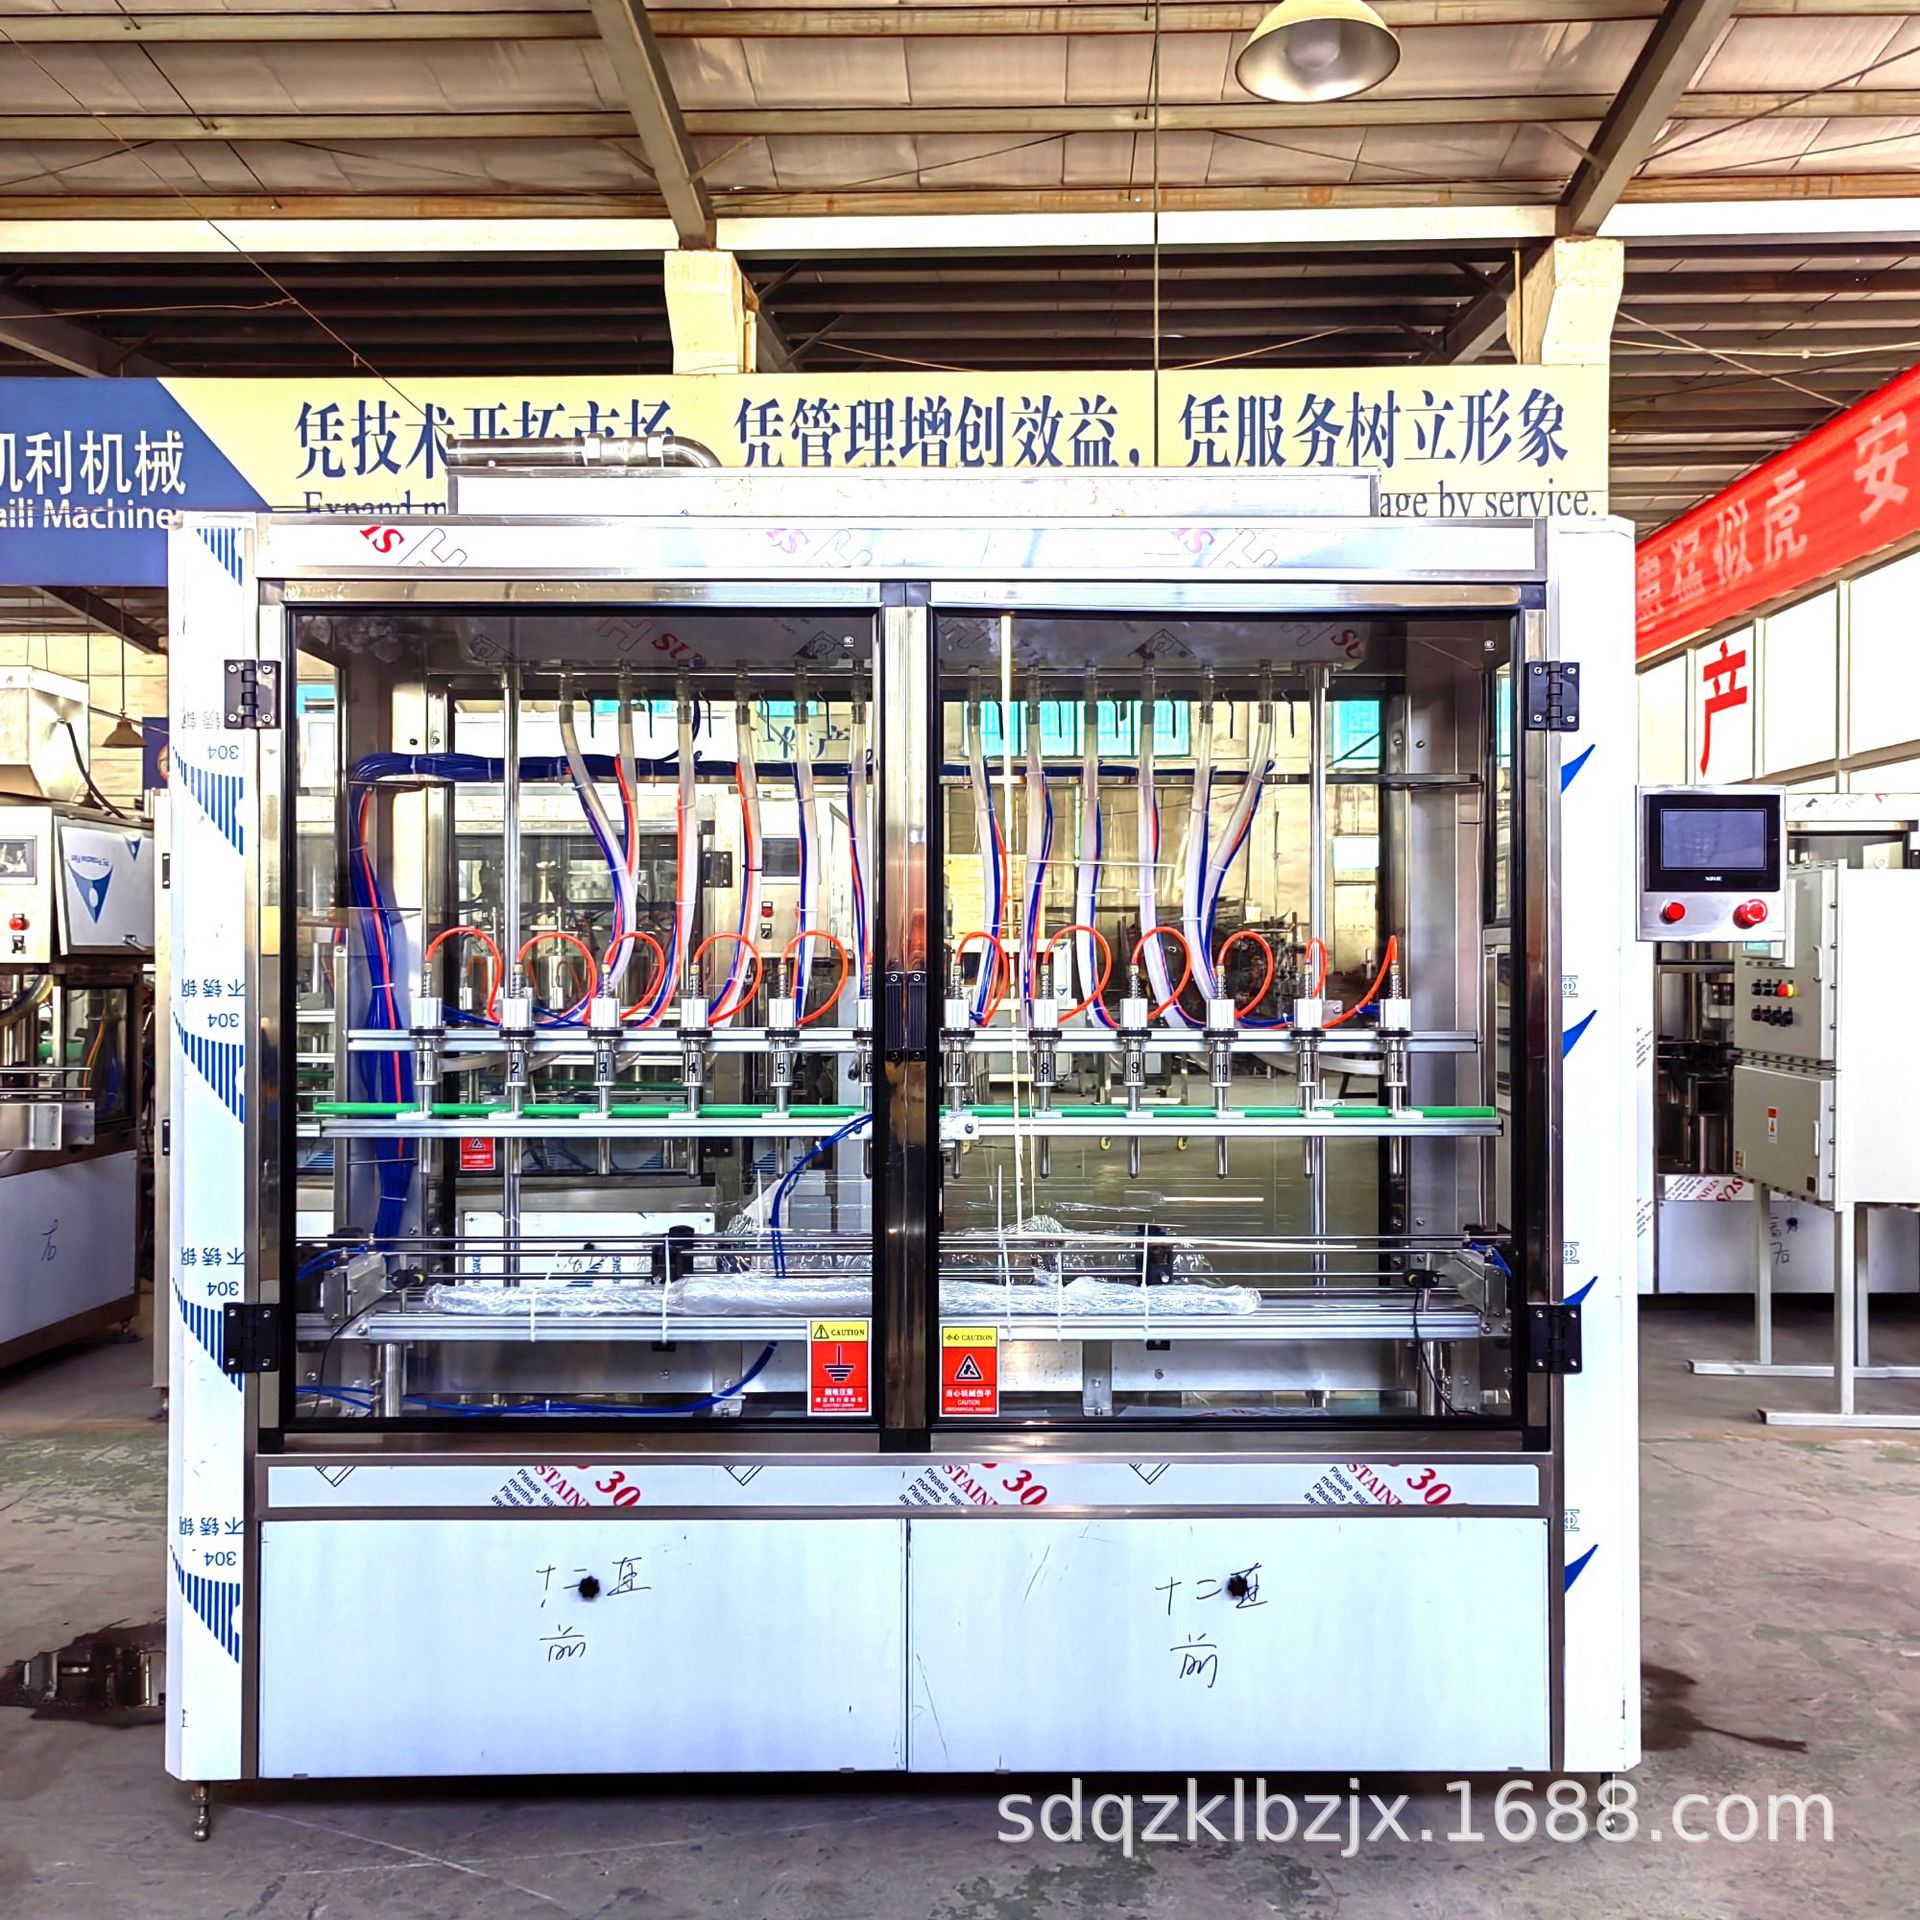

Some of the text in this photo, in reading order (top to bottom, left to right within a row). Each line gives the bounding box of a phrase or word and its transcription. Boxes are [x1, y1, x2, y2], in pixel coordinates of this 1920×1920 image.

[1178, 388, 1568, 468] 凭服务树立形象
[1854, 410, 1908, 524] 安
[1485, 478, 1597, 516] service.
[181, 711, 221, 730] 锈钢
[1703, 639, 1748, 778] 产
[207, 745, 239, 760] 304
[181, 979, 245, 998] 不锈钢
[207, 1013, 239, 1028] 304
[1216, 1063, 1228, 1075] 10
[181, 1246, 246, 1265] 不锈钢
[206, 1280, 240, 1296] 304
[508, 1477, 534, 1505] months
[517, 1468, 541, 1495] Please
[915, 1477, 942, 1504] months
[924, 1467, 949, 1493] Please
[1320, 1475, 1346, 1501] months
[1329, 1466, 1353, 1492] Please
[179, 1517, 244, 1537] 不锈钢
[203, 1550, 237, 1566] 304
